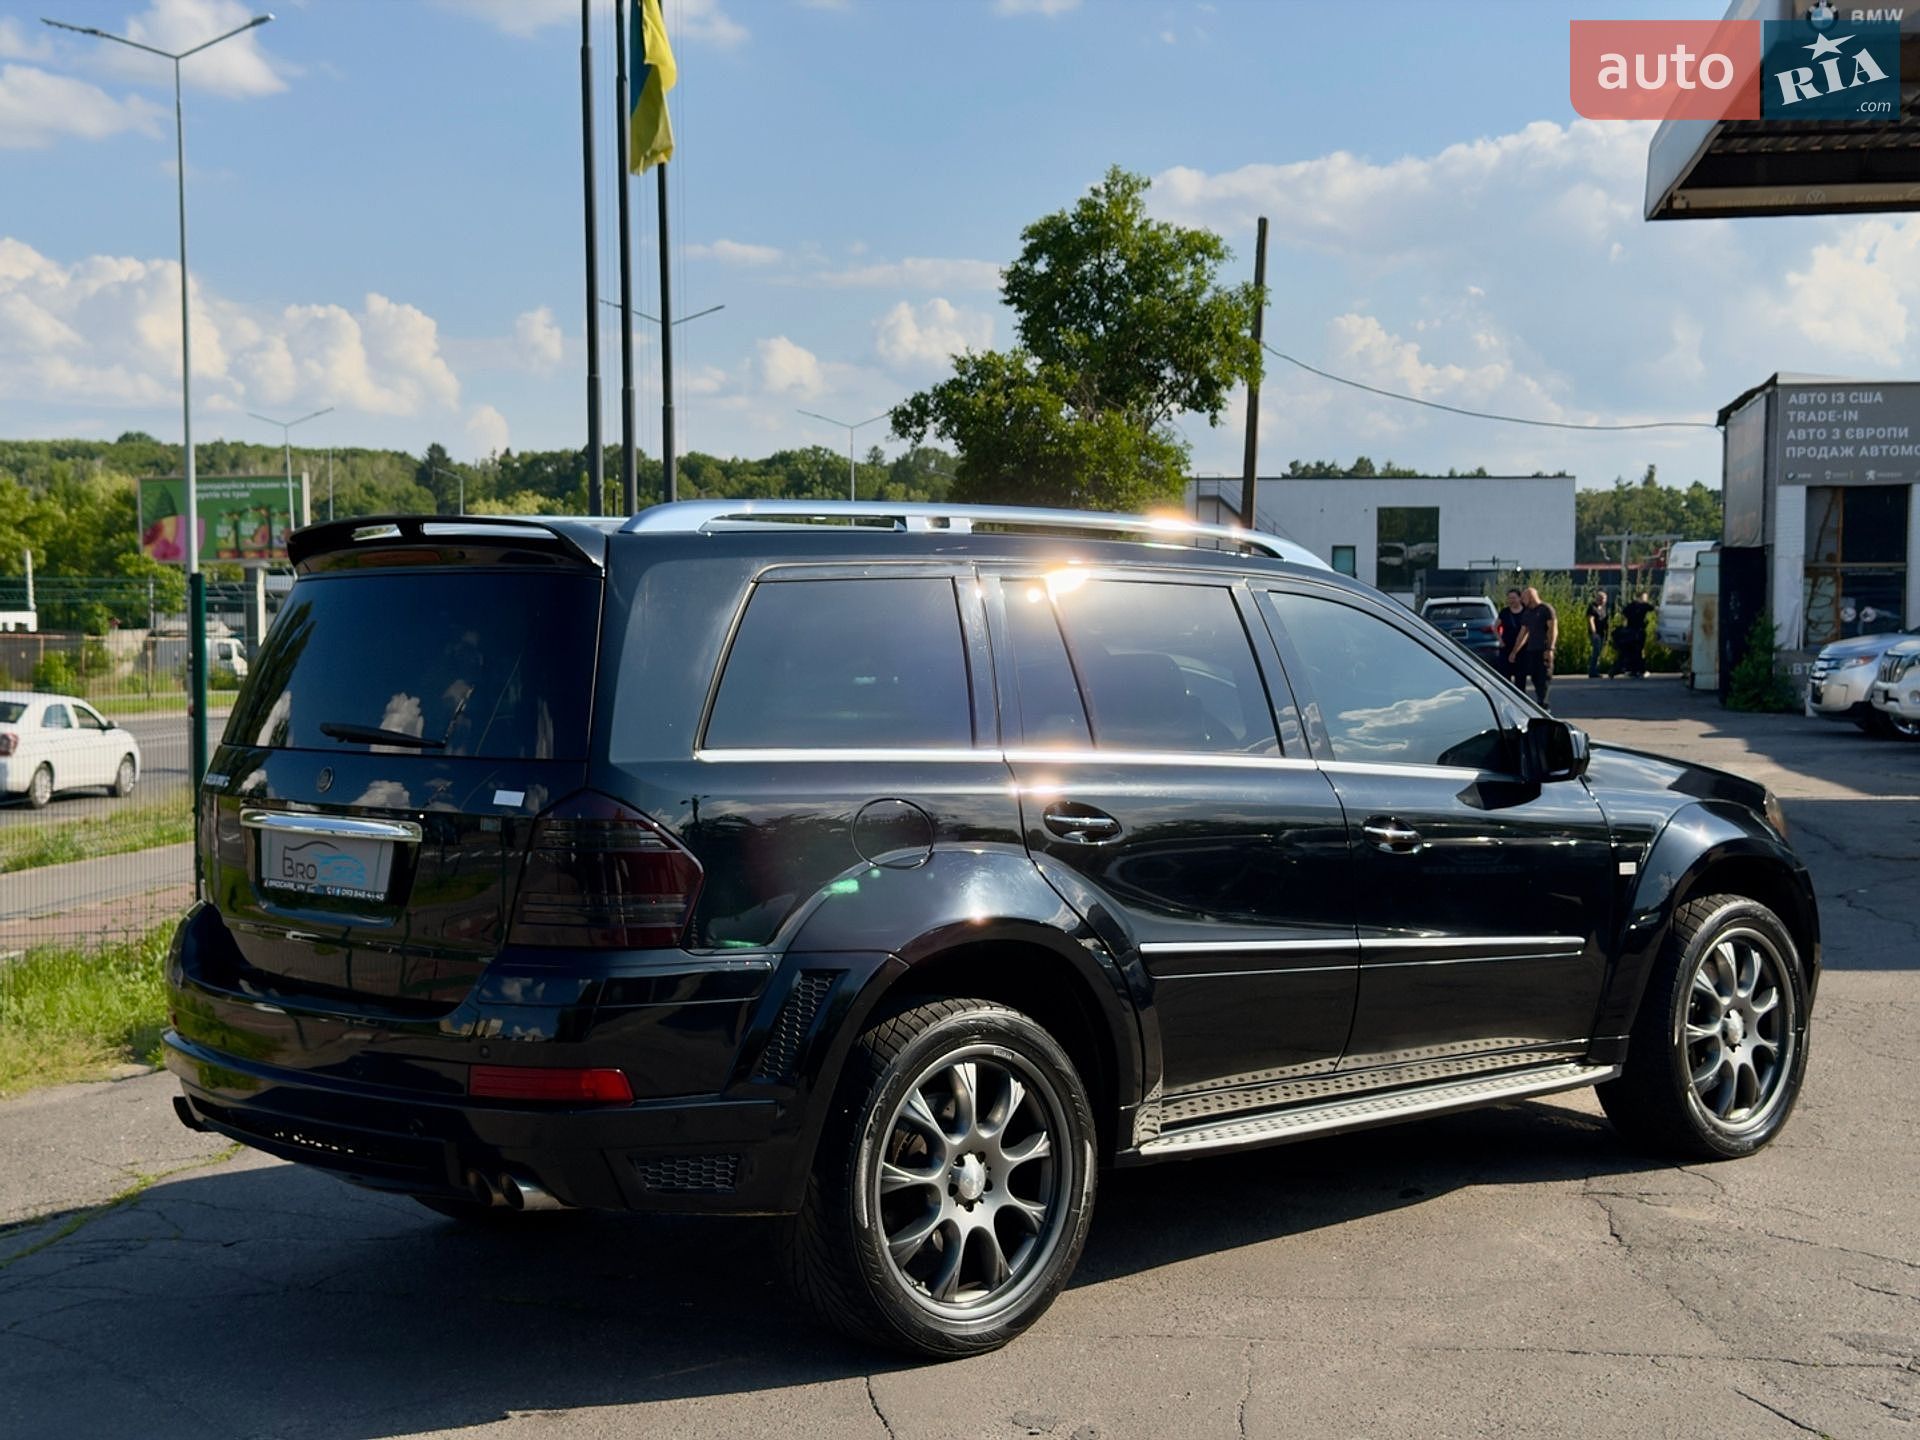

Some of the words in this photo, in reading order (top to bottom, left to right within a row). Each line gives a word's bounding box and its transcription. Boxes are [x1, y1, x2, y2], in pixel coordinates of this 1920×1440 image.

[1851, 8, 1904, 25] BMW
[1788, 392, 1827, 405] АВТО
[1831, 392, 1845, 404] ІЗ
[1848, 391, 1883, 404] США
[1787, 410, 1859, 423] TRADE-IN
[1786, 428, 1827, 441] АВТО
[1845, 426, 1909, 440] ЄВРОПИ
[1785, 446, 1855, 460] ПРОДАЖ
